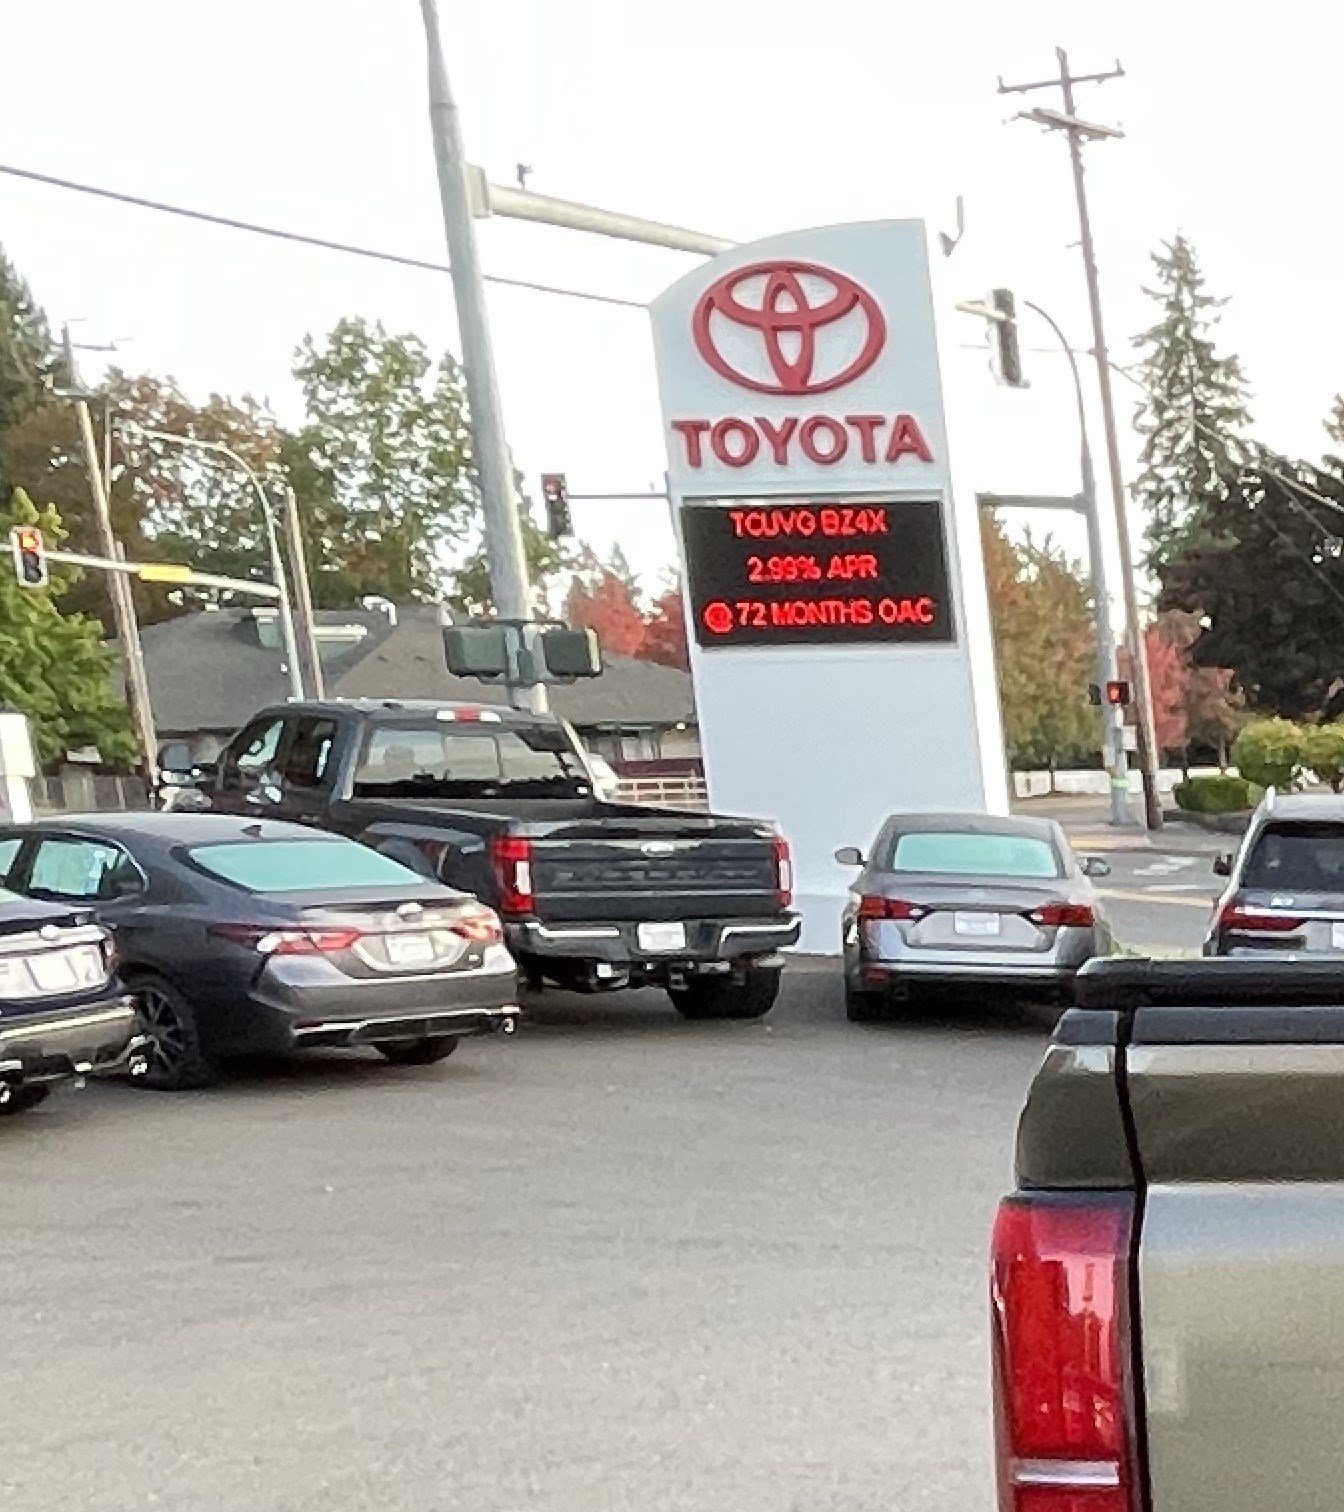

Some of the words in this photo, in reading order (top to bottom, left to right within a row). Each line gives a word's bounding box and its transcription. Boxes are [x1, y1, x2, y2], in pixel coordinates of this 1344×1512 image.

[671, 413, 935, 468] TOYOTA
[826, 553, 879, 580] APR
[735, 601, 768, 627] 72
[770, 599, 873, 627] MONTHS
[878, 596, 934, 625] OAC
